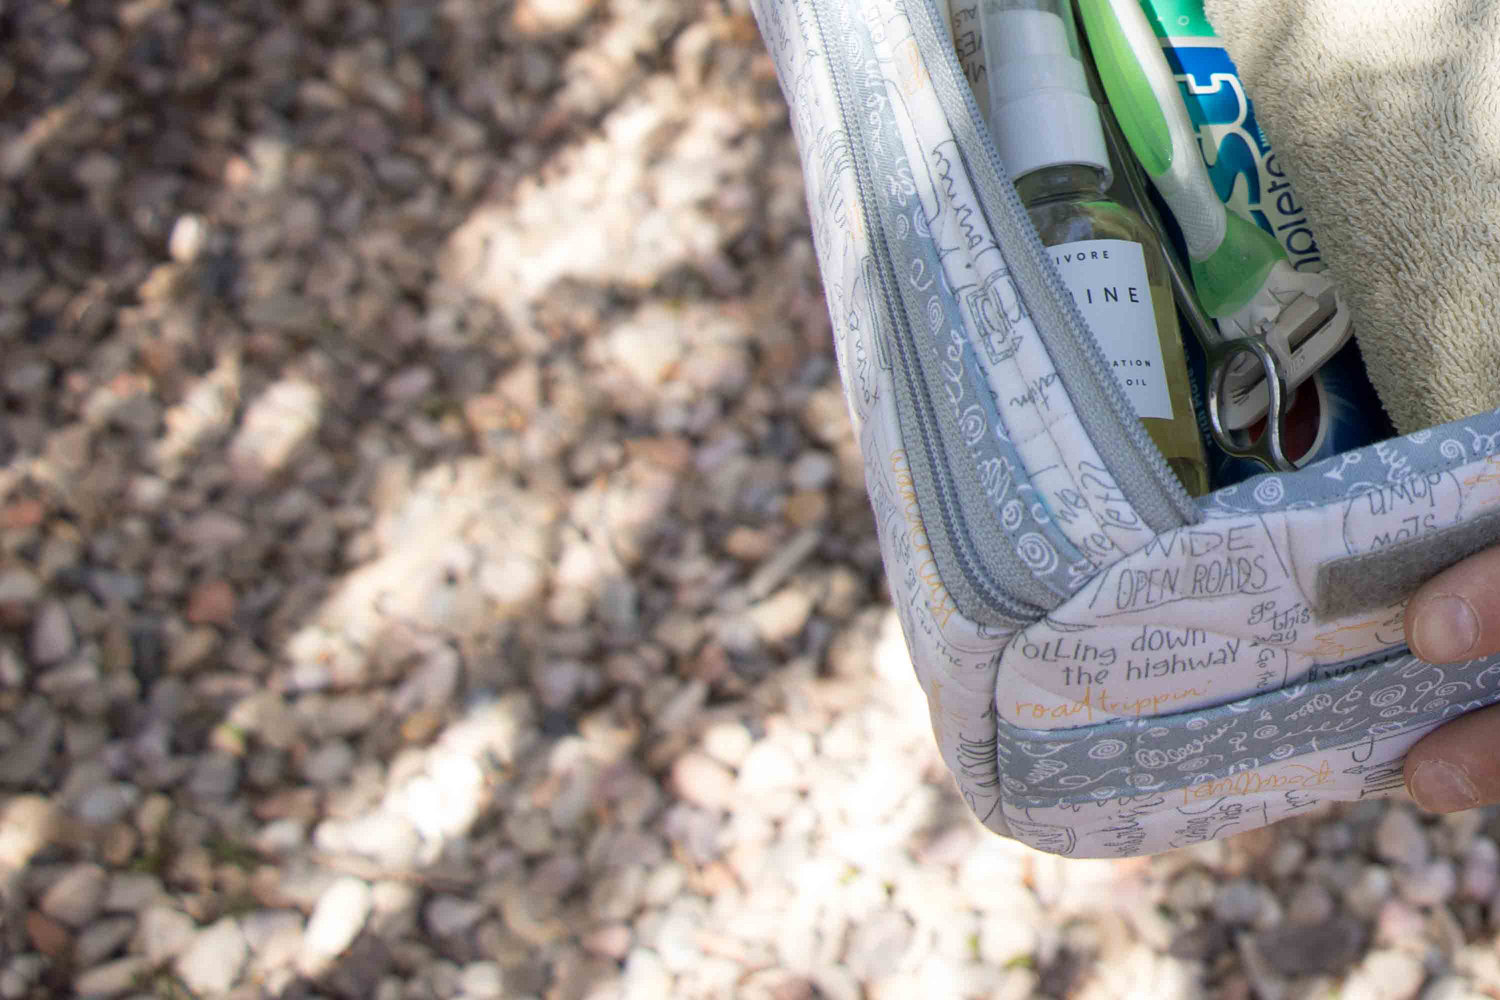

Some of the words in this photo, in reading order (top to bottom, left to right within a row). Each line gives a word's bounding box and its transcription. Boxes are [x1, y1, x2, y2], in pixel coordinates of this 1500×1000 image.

[1055, 249, 1111, 266] IVORE
[1085, 286, 1140, 304] INE
[1111, 358, 1152, 368] ATION
[1125, 377, 1147, 388] OIL
[1144, 523, 1256, 559] WIDE
[1115, 566, 1180, 610] OPEN
[1191, 554, 1270, 595] ROADS
[1247, 600, 1276, 625] go
[1265, 603, 1311, 631] this
[1130, 624, 1208, 653] down
[1061, 665, 1110, 687] the
